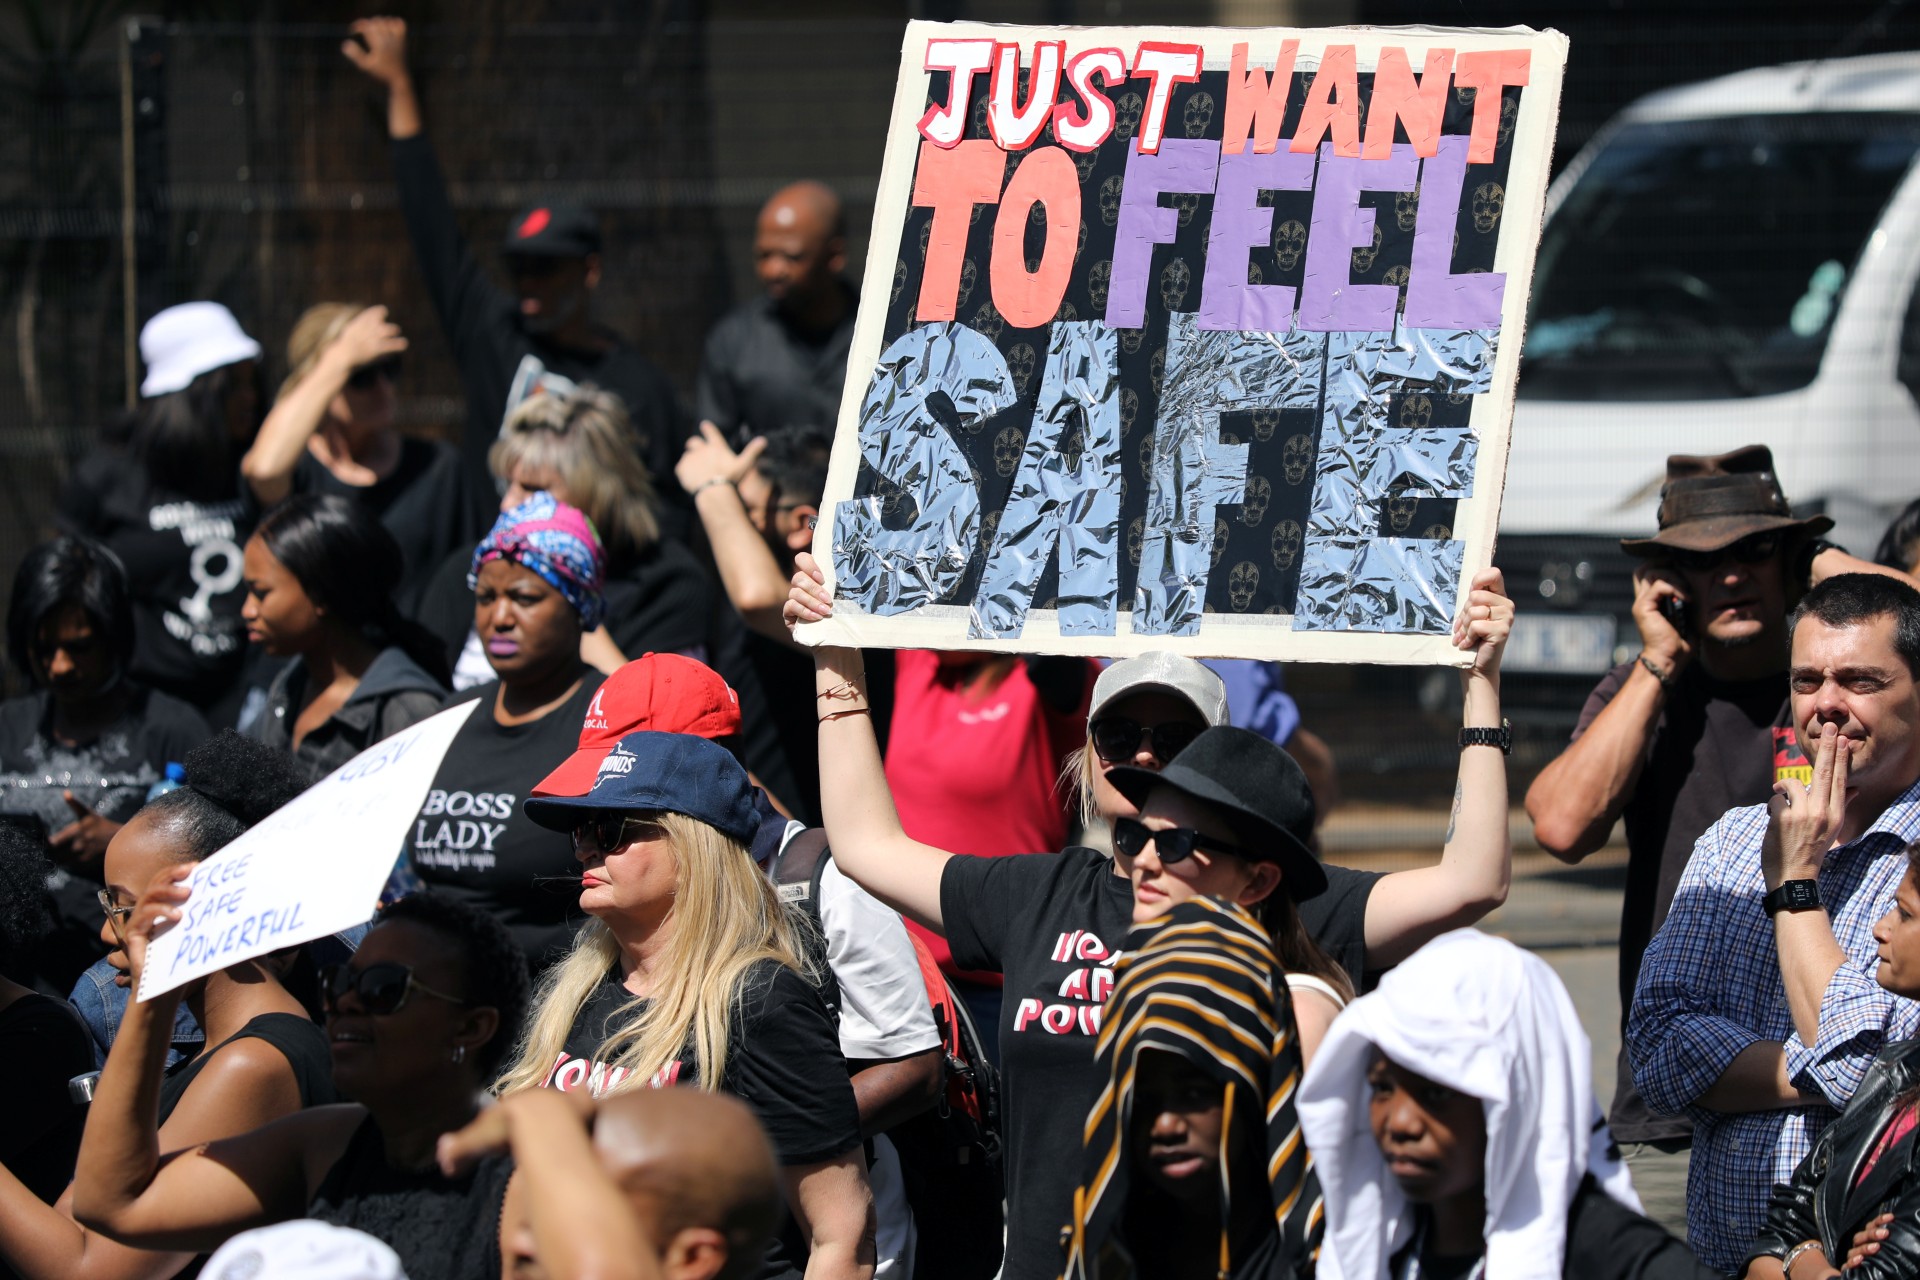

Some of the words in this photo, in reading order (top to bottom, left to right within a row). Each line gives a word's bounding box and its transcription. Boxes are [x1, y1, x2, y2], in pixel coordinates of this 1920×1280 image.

[916, 38, 1204, 154] JUST
[1221, 39, 1531, 164] WANT
[912, 139, 1082, 328] TO
[1105, 135, 1508, 333] FEEL
[832, 312, 1503, 640] SAFE
[414, 819, 508, 850] LADY
[421, 789, 516, 819] BOSS
[191, 853, 253, 894] FREE
[169, 901, 305, 977] POWERFUL
[183, 886, 247, 932] SAFE
